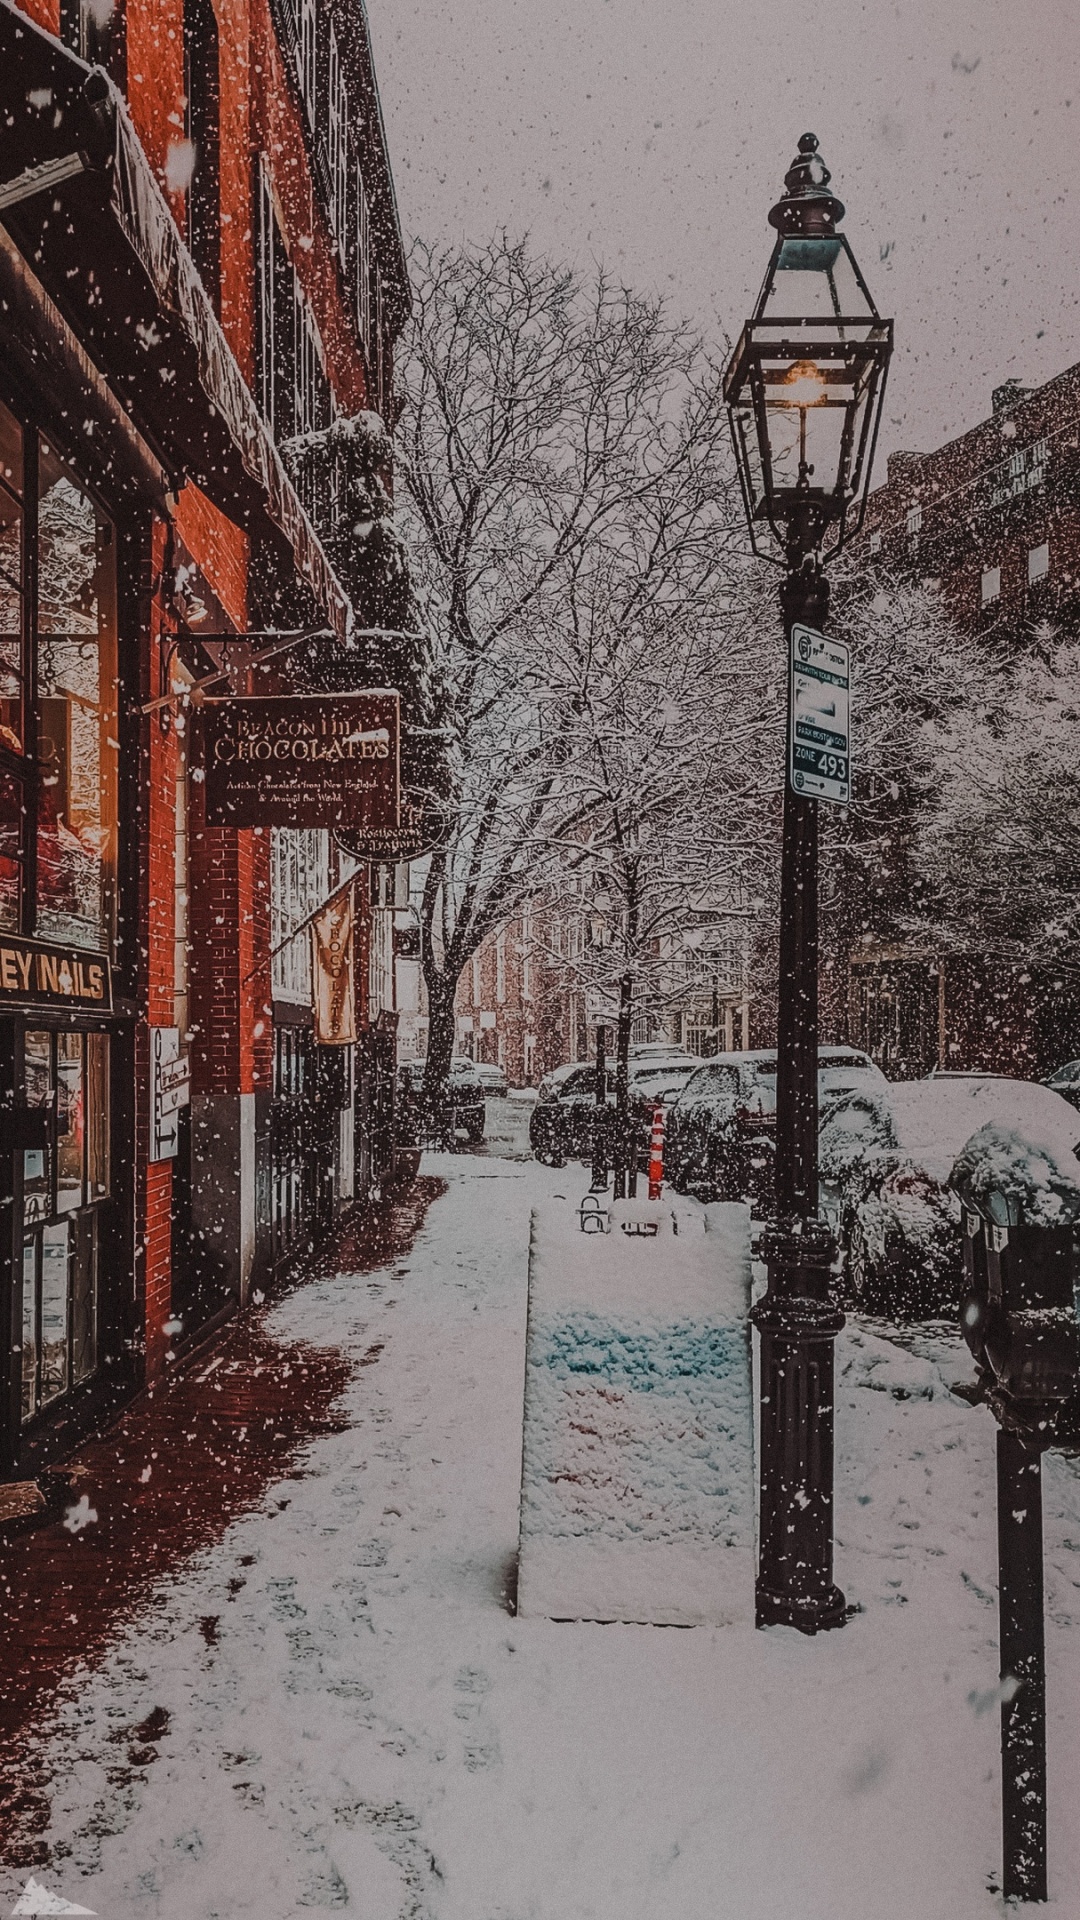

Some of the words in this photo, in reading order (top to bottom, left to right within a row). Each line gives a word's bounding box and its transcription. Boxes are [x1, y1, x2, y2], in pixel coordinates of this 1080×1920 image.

[819, 671, 831, 681] YOUR
[237, 721, 315, 736] BEACON
[214, 737, 390, 761] CHOCOLATES
[795, 746, 816, 763] ZONE
[817, 753, 846, 779] 493
[300, 781, 321, 791] from
[323, 780, 342, 789] New
[258, 794, 267, 802] &
[0, 948, 33, 991] EY
[36, 953, 104, 999] NAILS
